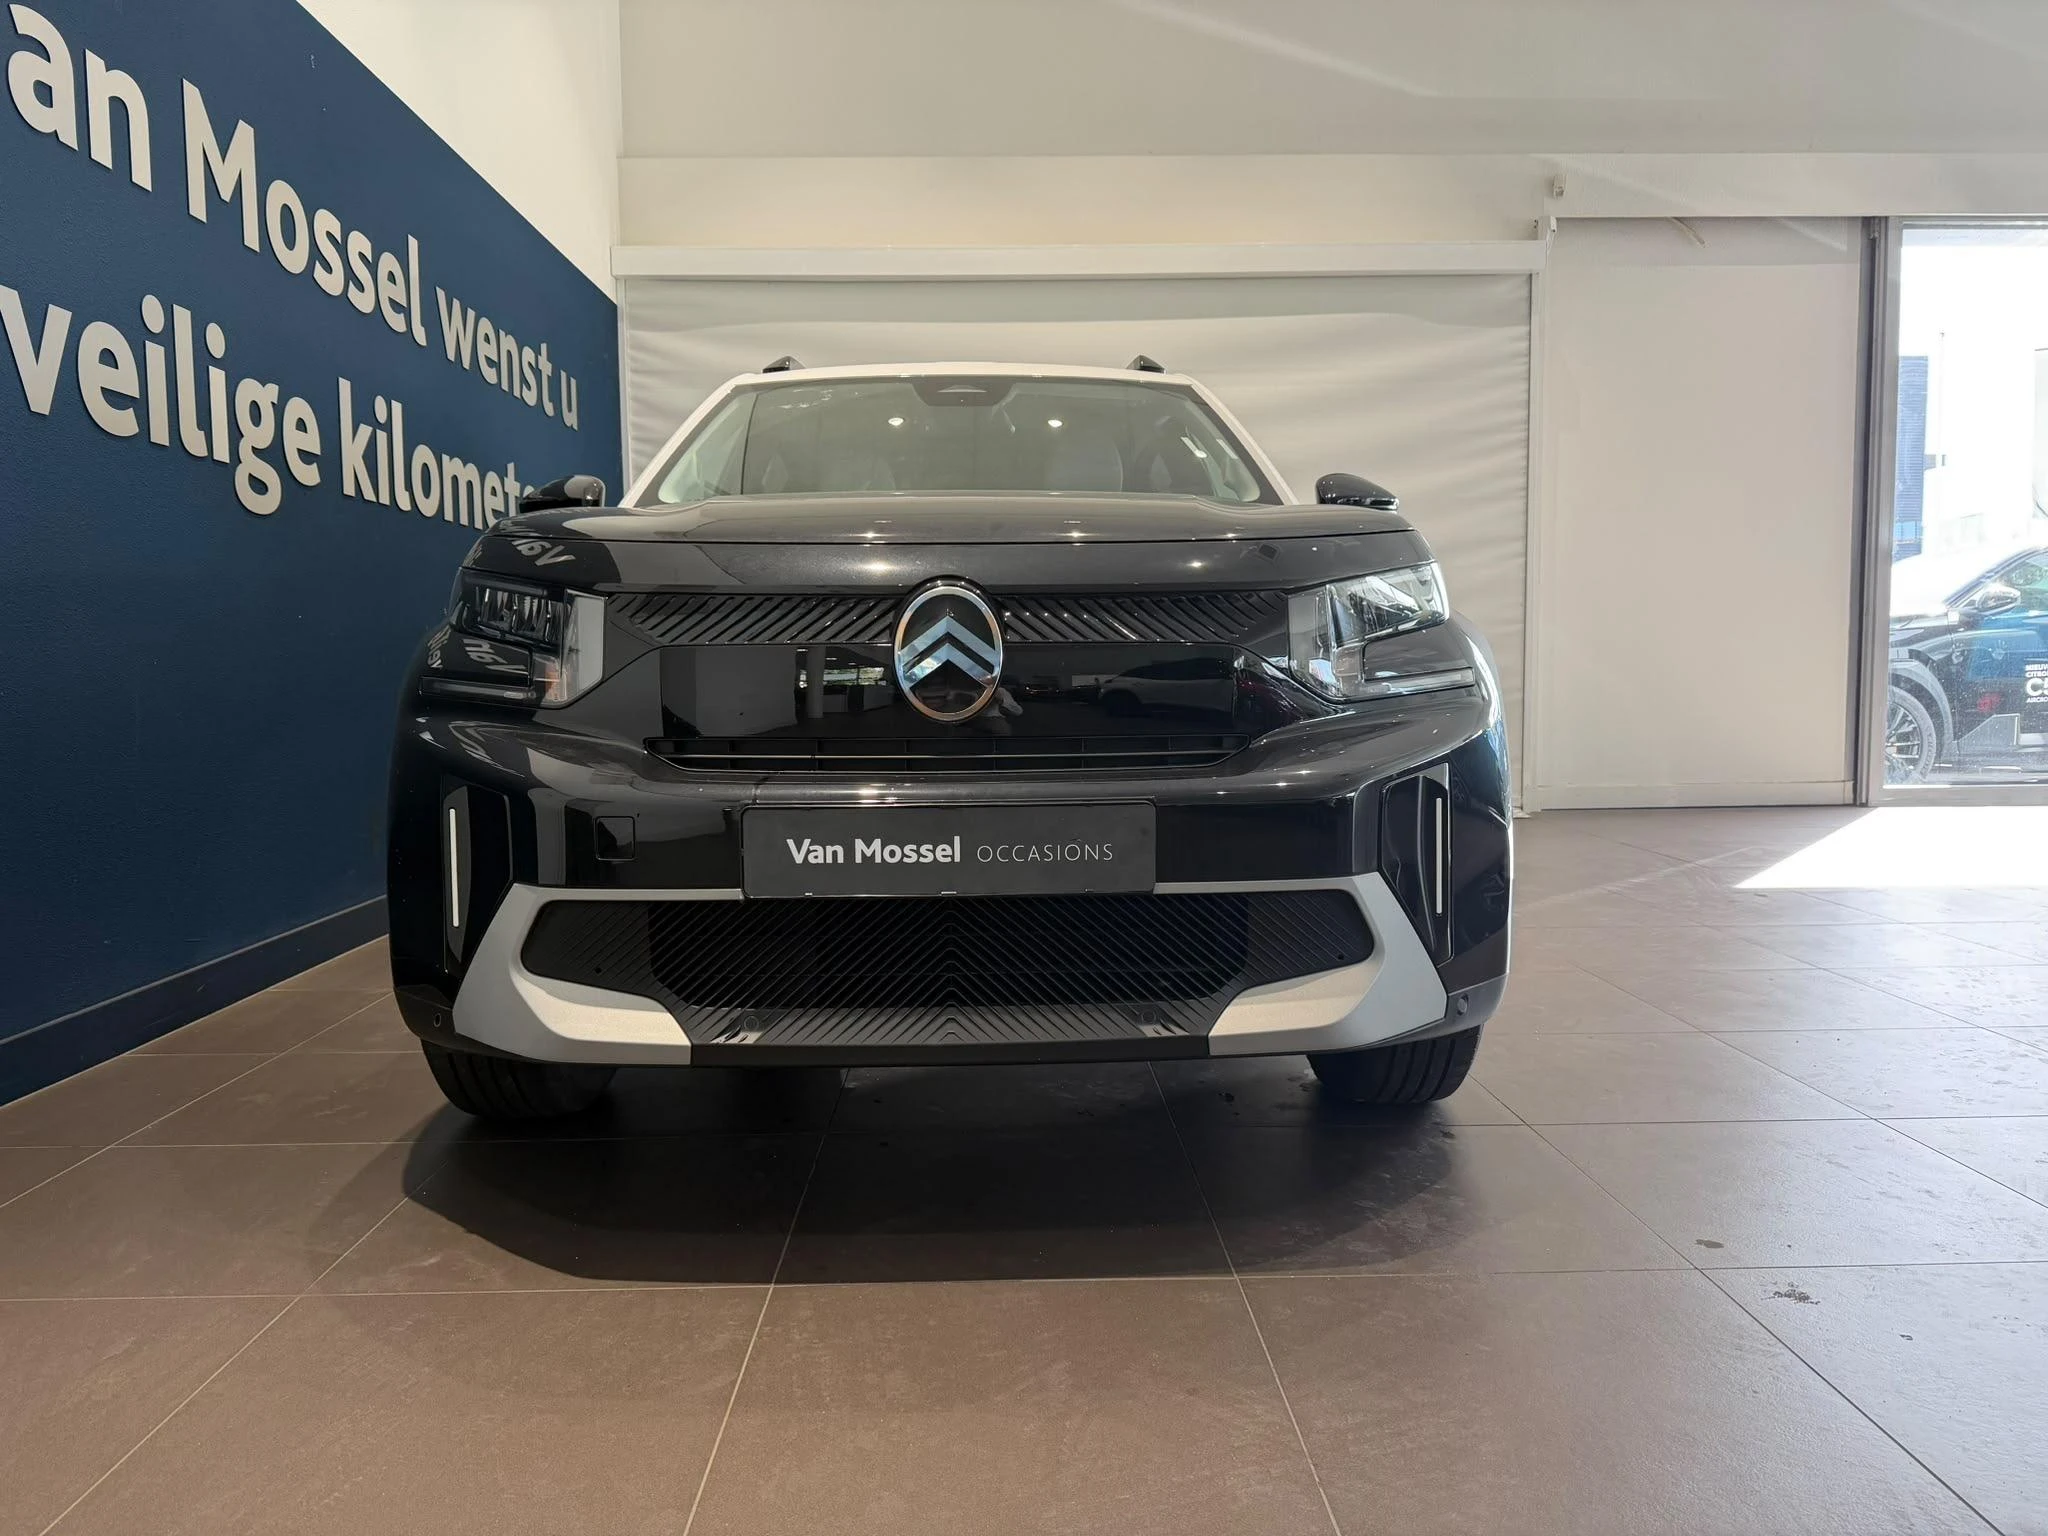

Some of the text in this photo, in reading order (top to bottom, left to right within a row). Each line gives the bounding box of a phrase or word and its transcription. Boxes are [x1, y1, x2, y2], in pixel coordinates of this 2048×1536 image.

[8, 3, 578, 431] an Mossel wenst u
[0, 284, 535, 530] veilige kilomet
[786, 835, 1114, 864] Van Mossel OCCASIONS
